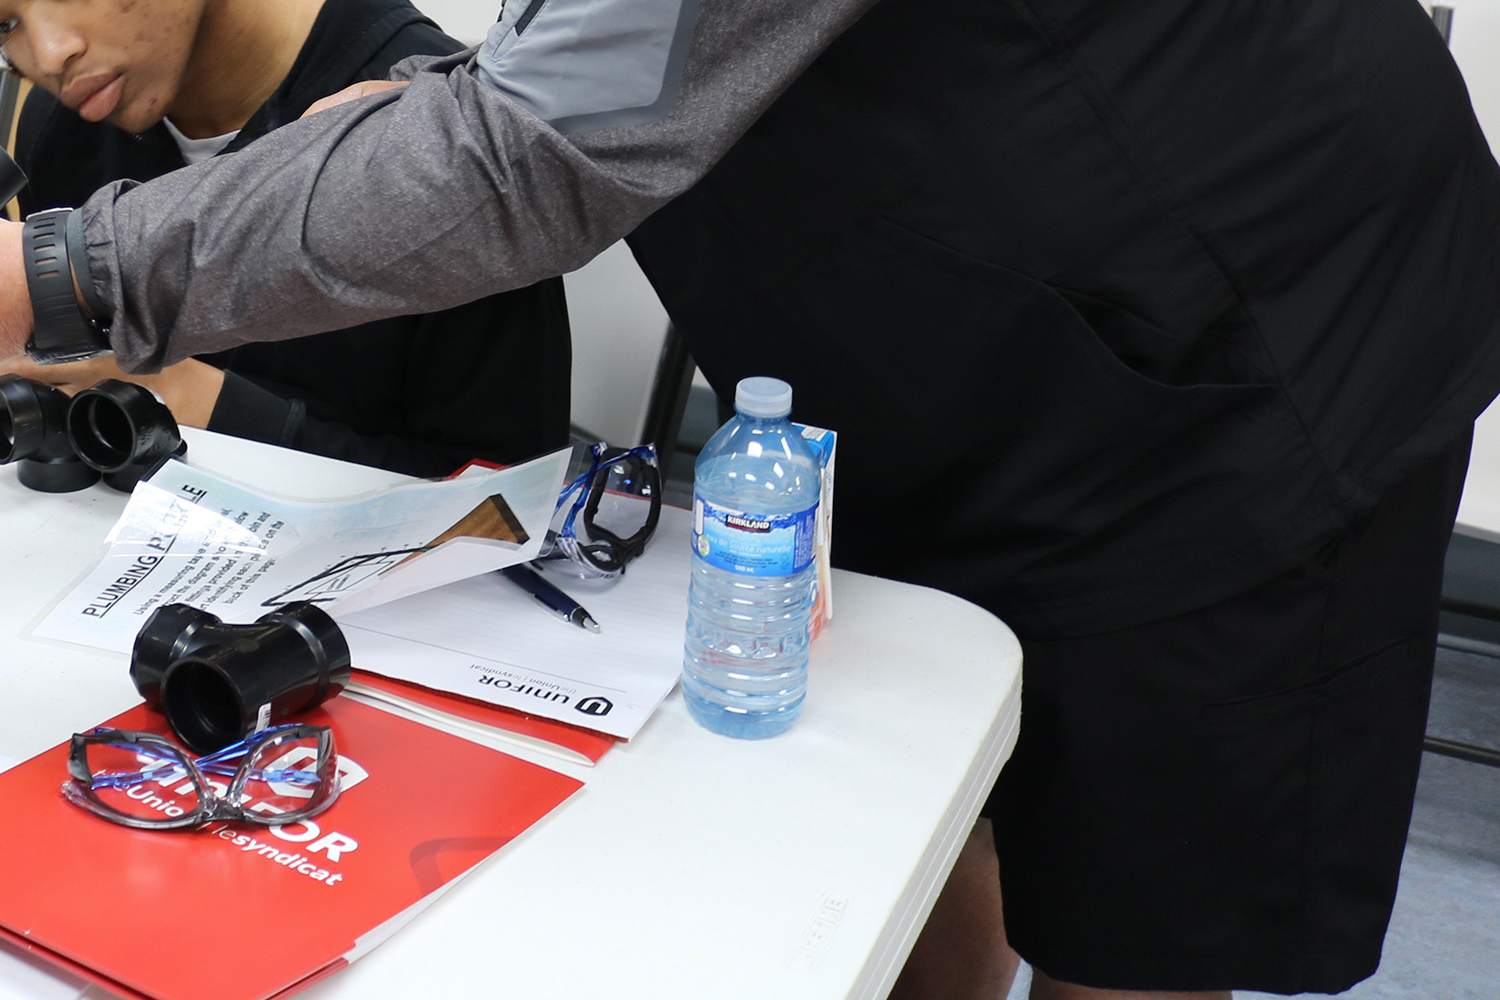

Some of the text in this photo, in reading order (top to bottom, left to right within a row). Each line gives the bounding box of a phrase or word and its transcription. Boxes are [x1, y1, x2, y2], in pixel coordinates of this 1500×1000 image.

[265, 529, 277, 539] on
[726, 514, 771, 530] KIRKLAND
[82, 484, 205, 617] PLUMBING PLE
[188, 562, 216, 584] diagram
[208, 559, 237, 584] provided
[133, 597, 159, 615] Using
[159, 565, 195, 593] measuring
[478, 675, 570, 704] UNIFOR
